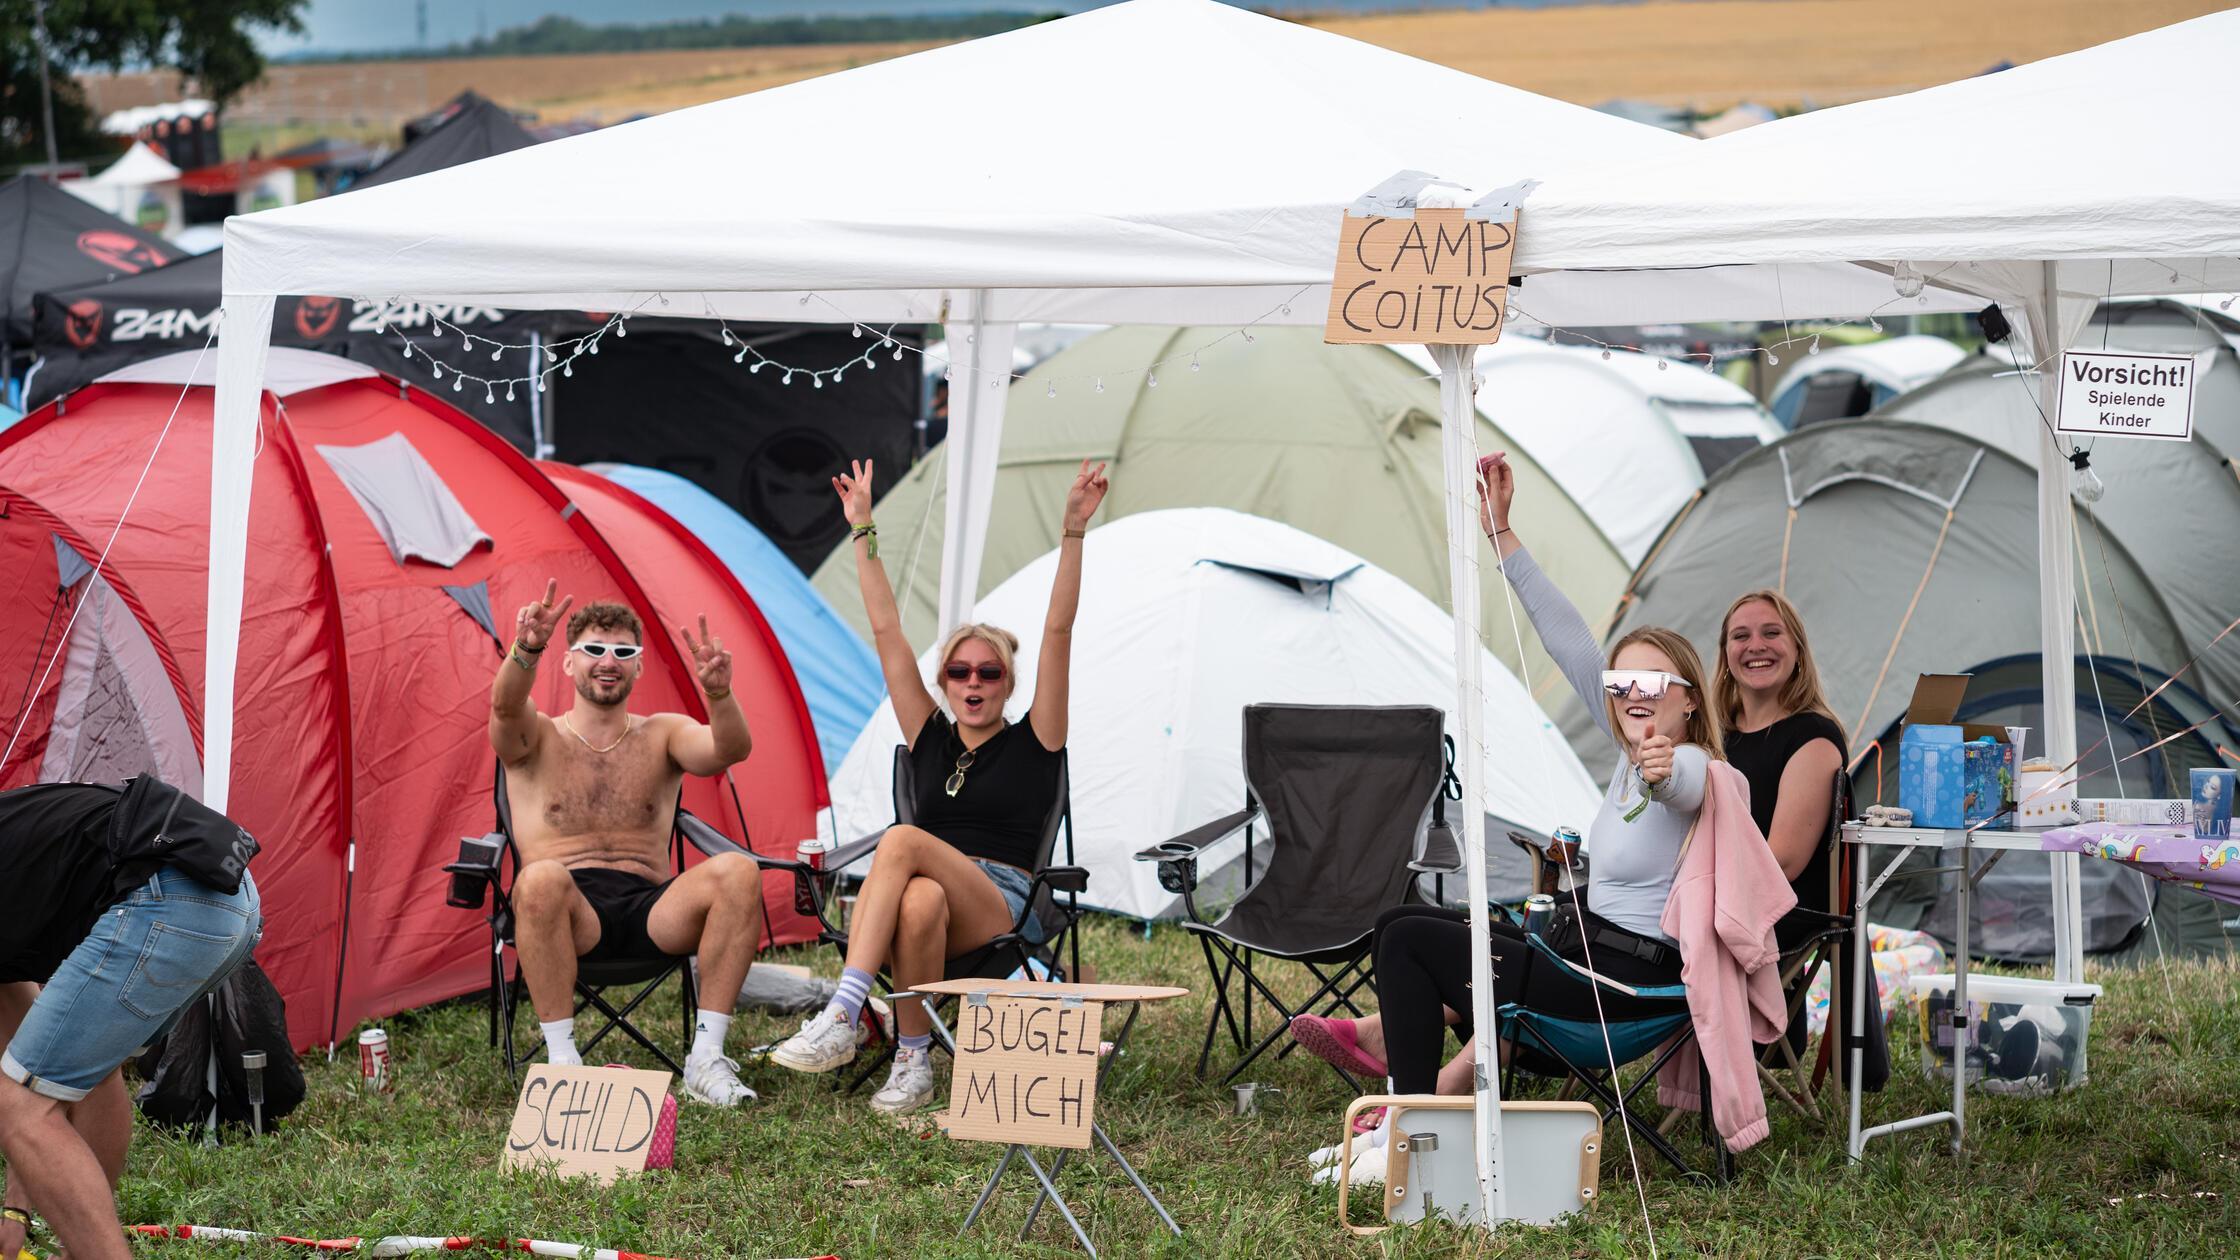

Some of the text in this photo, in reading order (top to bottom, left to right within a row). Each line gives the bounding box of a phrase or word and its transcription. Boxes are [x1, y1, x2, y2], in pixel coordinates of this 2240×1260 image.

[1356, 218, 1511, 276] CAMP
[111, 308, 219, 341] 24M
[2072, 360, 2186, 388] Vorsicht!
[2088, 390, 2166, 408] Spielende
[2099, 412, 2152, 428] Kinder
[963, 1003, 1096, 1057] BÜGEL
[509, 1076, 654, 1153] SCHILD
[961, 1069, 1084, 1129] MICH
